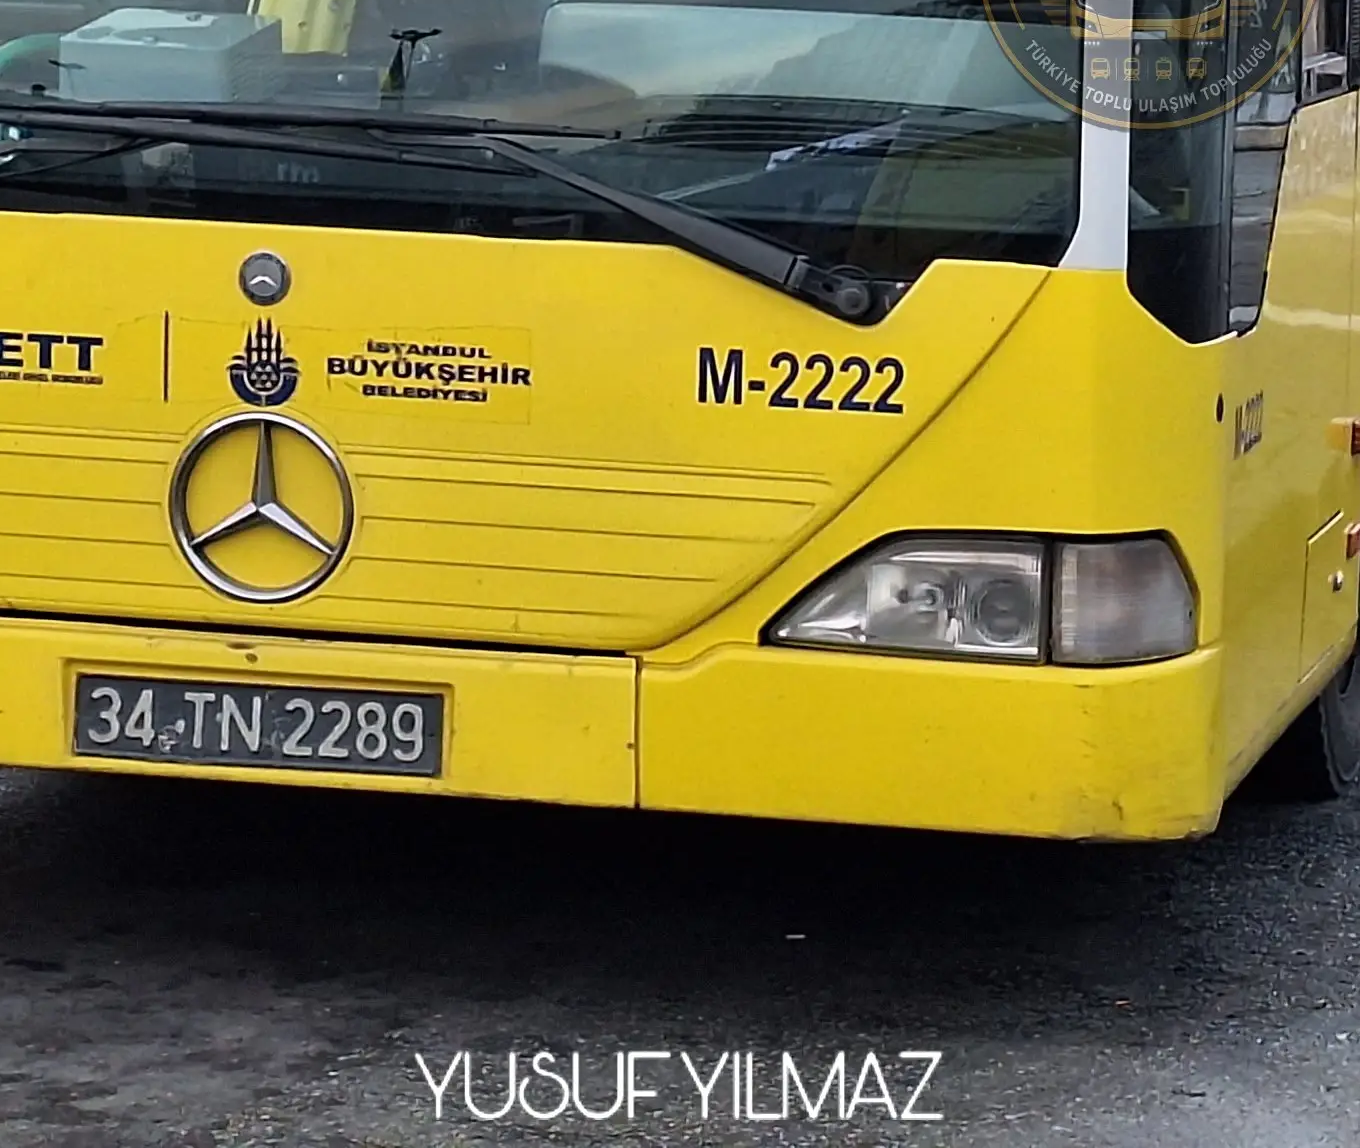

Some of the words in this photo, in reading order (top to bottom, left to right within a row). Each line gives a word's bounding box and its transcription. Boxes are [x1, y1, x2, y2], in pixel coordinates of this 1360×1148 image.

[366, 339, 493, 361] İSTANBUL
[327, 355, 532, 387] BÜYÜKŞEHİR
[696, 346, 905, 414] M-2222
[361, 383, 488, 403] BELEDİYESİ
[87, 686, 155, 748] 34
[184, 691, 262, 753] TN
[281, 698, 425, 763] 2289
